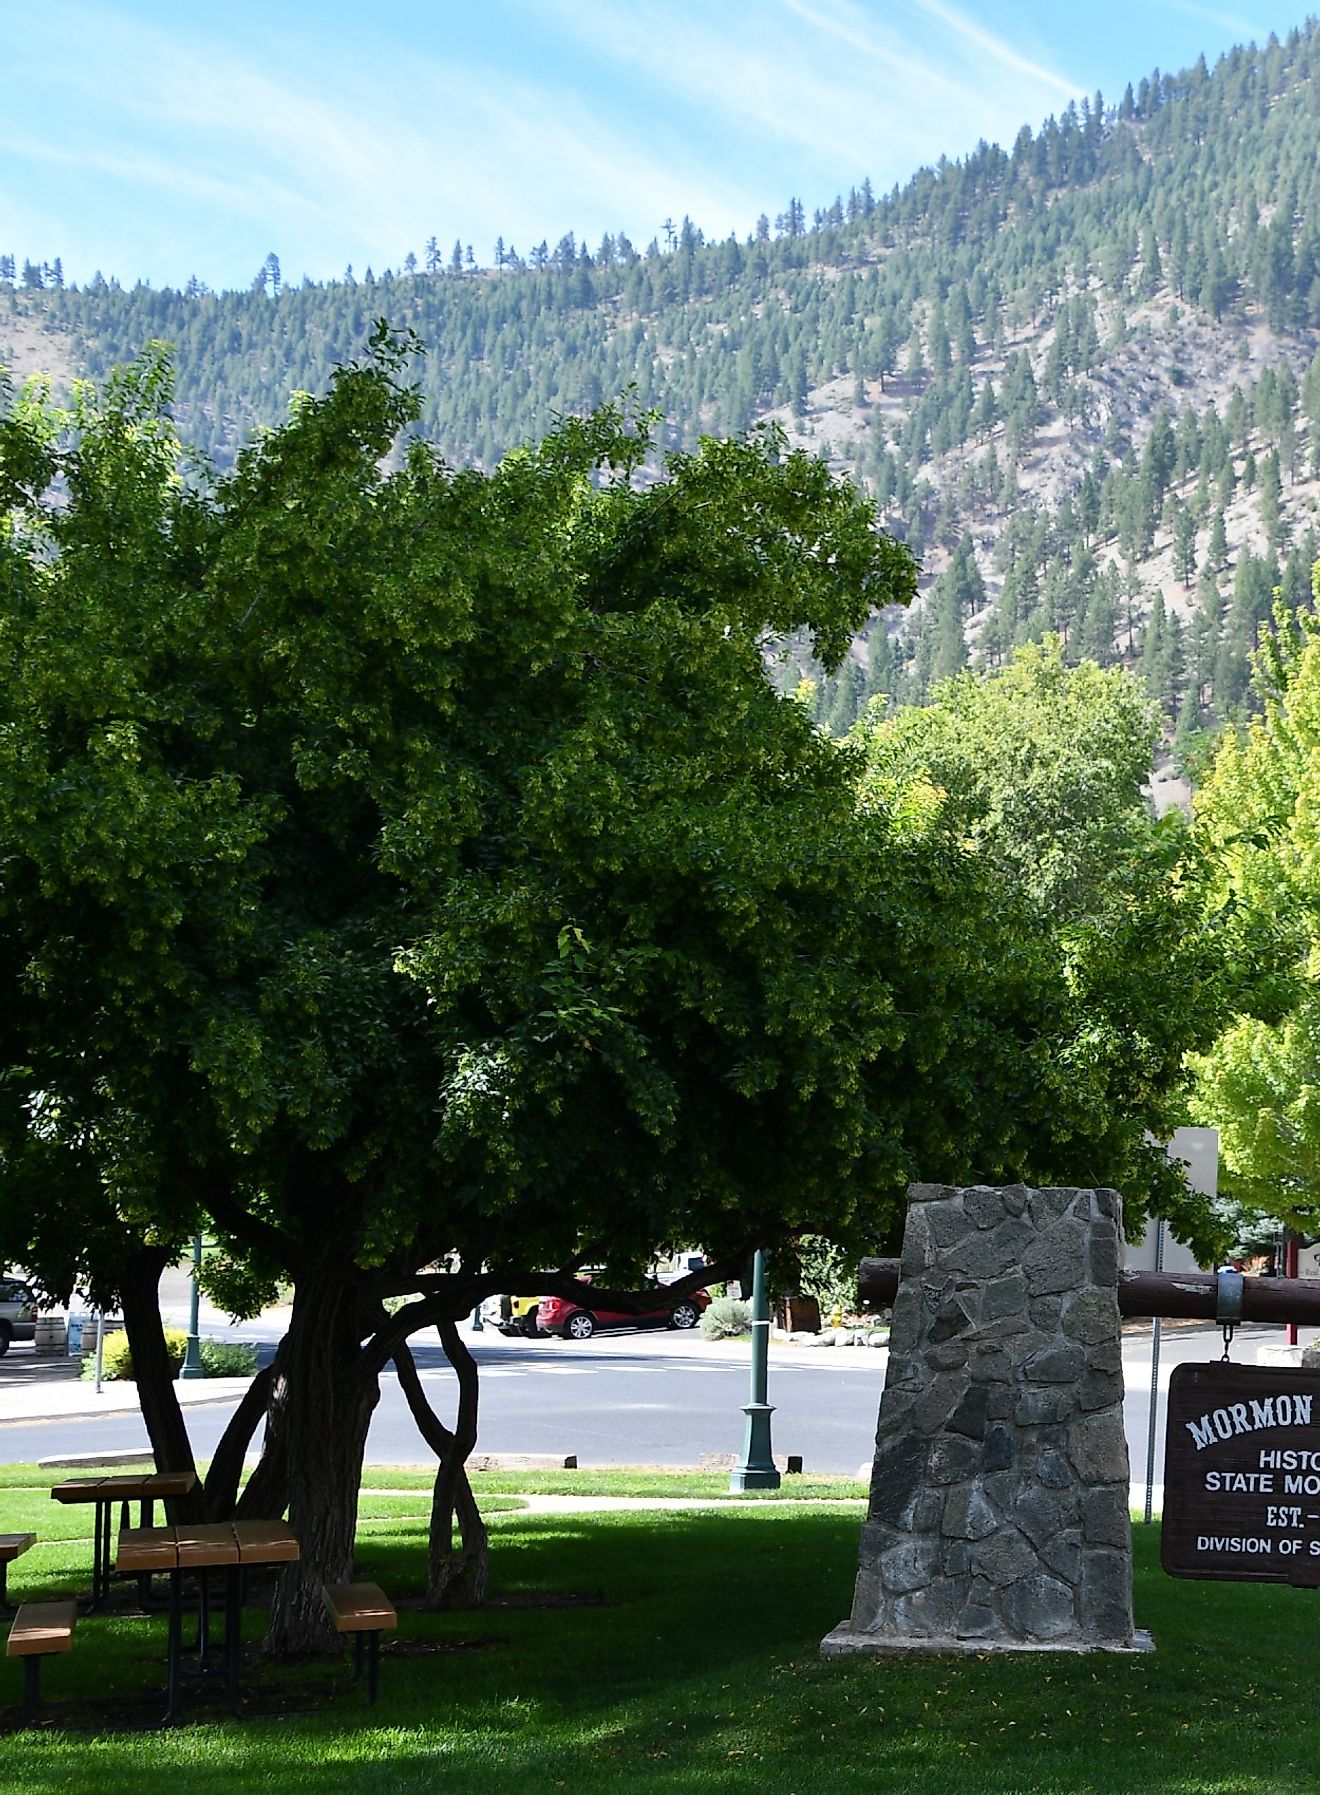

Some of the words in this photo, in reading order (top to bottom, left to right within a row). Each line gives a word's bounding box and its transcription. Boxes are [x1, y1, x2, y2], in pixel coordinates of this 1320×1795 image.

[1185, 1394, 1313, 1451] MORMON
[1205, 1471, 1274, 1493] STATE
[1197, 1536, 1272, 1554] DIVISION
[1278, 1539, 1303, 1555] OF
